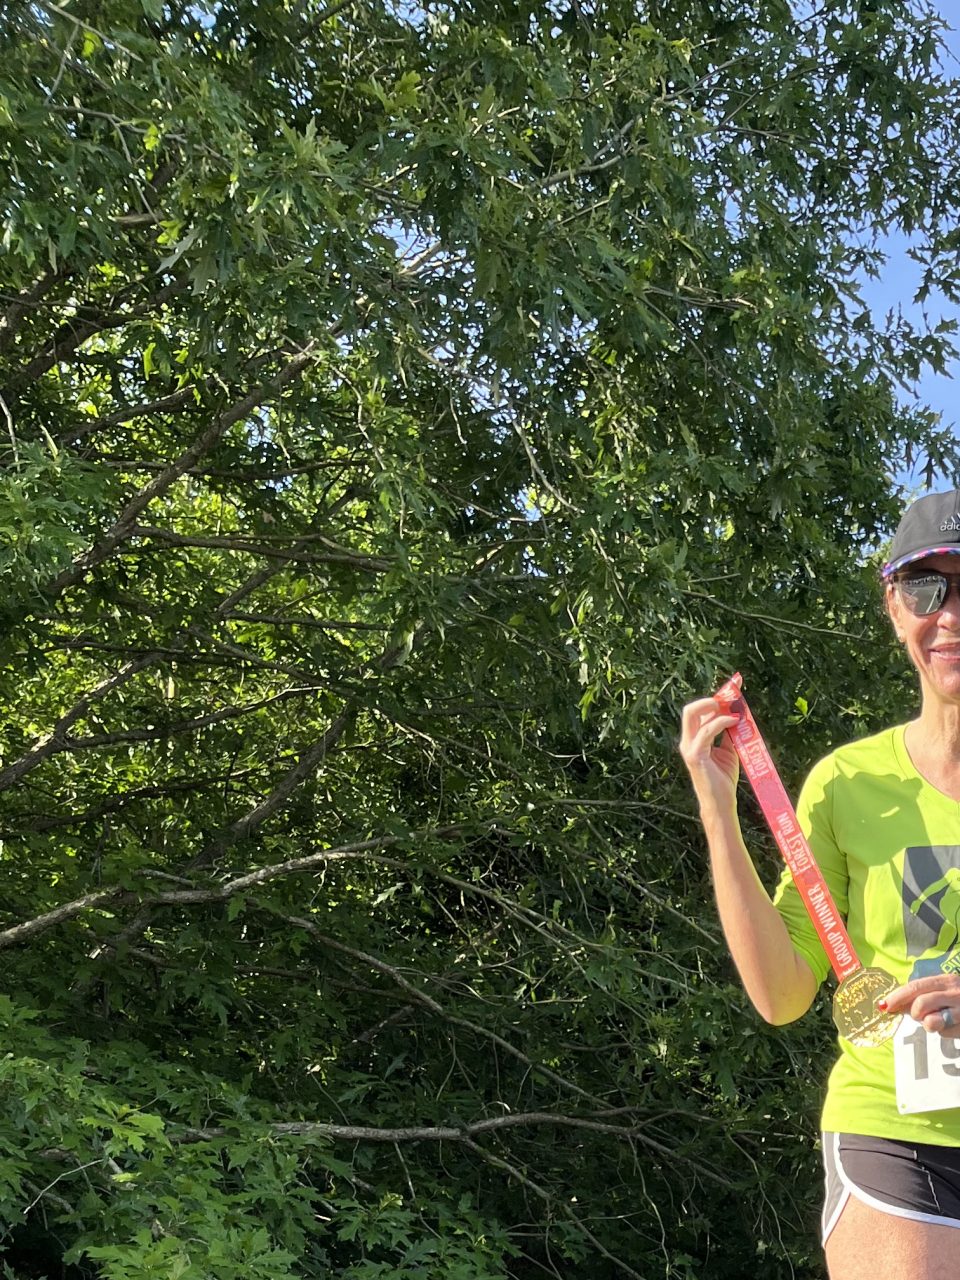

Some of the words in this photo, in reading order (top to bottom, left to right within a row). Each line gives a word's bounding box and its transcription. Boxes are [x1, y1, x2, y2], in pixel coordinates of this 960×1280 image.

[744, 739, 769, 777] FOREST
[776, 812, 795, 835] RUN
[786, 834, 812, 873] FOREST
[807, 883, 838, 933] WINNER
[827, 931, 853, 967] GROUP
